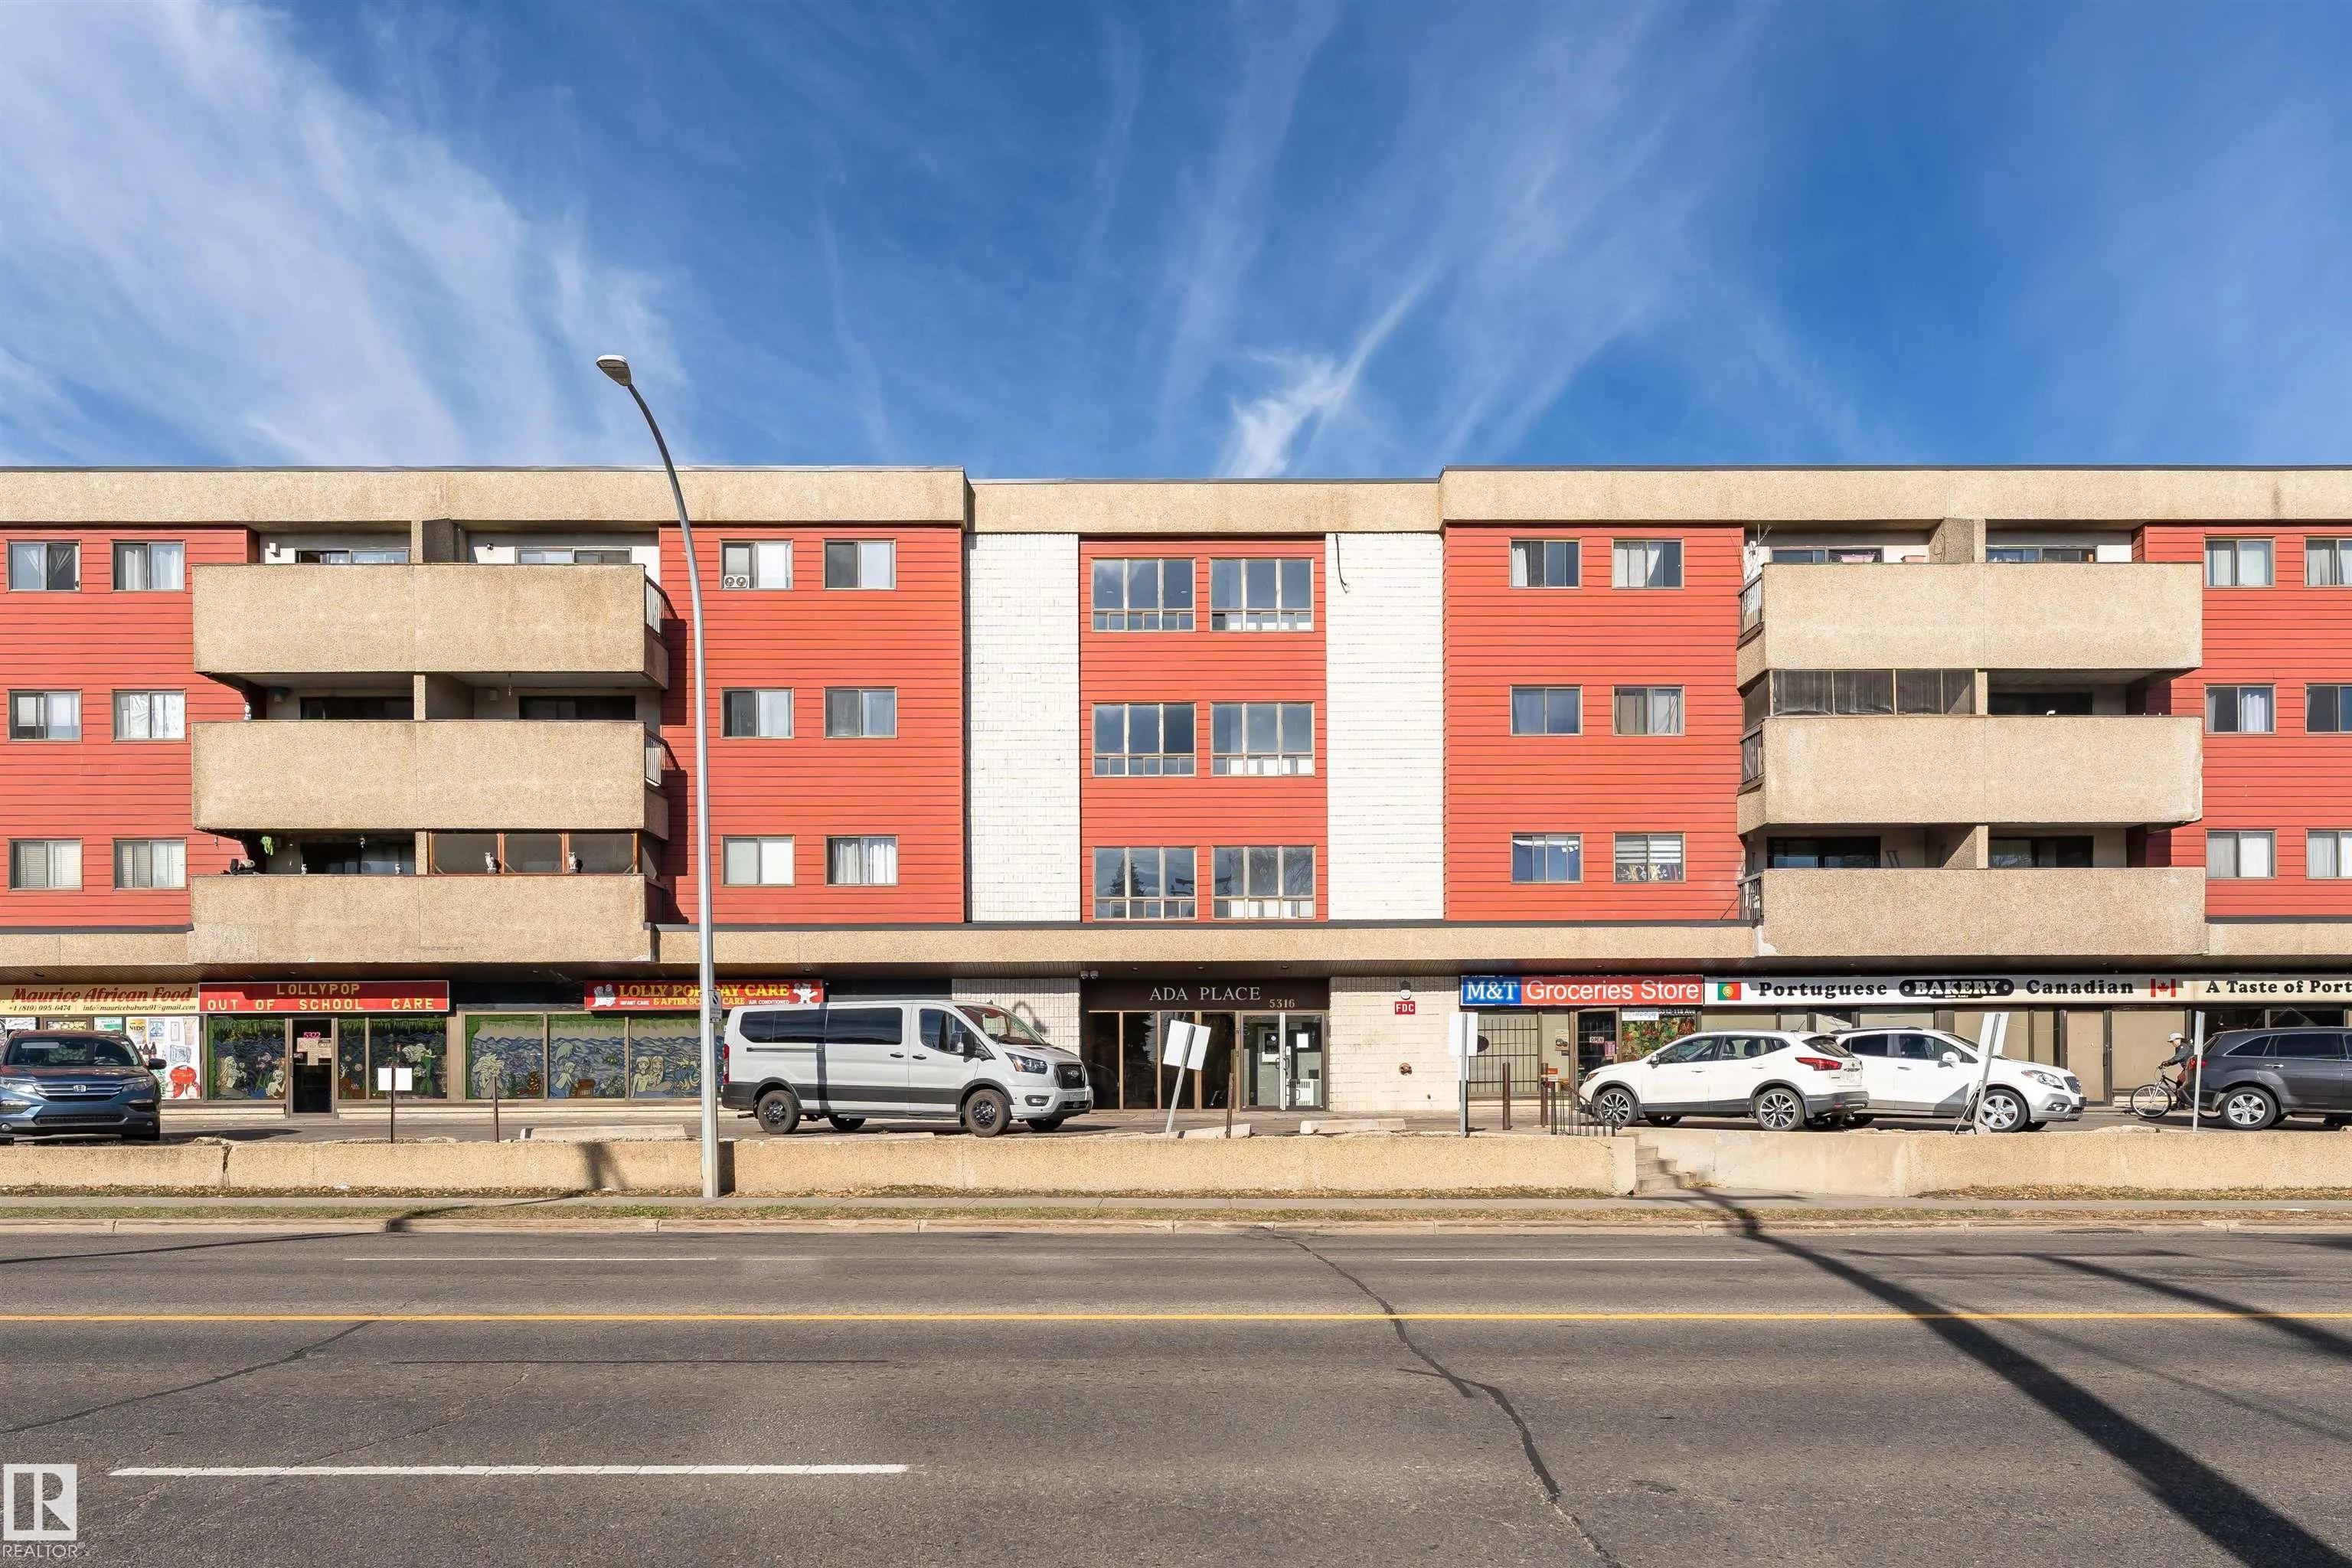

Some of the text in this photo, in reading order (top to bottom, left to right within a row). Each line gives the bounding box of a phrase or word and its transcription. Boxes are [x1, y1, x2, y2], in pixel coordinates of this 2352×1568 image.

[276, 984, 360, 995] LOLLYPOP
[619, 985, 668, 997] LOLLY
[744, 985, 789, 996] CARE
[1467, 980, 1699, 1000] M&T Groceries Store
[1759, 979, 2134, 999] Portuguese BAKERY Canadian
[2206, 980, 2220, 993] A
[2226, 980, 2278, 993] Taste
[2284, 980, 2304, 993] of
[11, 987, 193, 1002] Maurice African Food
[1149, 987, 1261, 1001] ADA PLACE
[207, 998, 434, 1011] OUT OF SCHOOL CARE
[1269, 998, 1295, 1008] 5316
[1396, 1003, 1415, 1012] FDC
